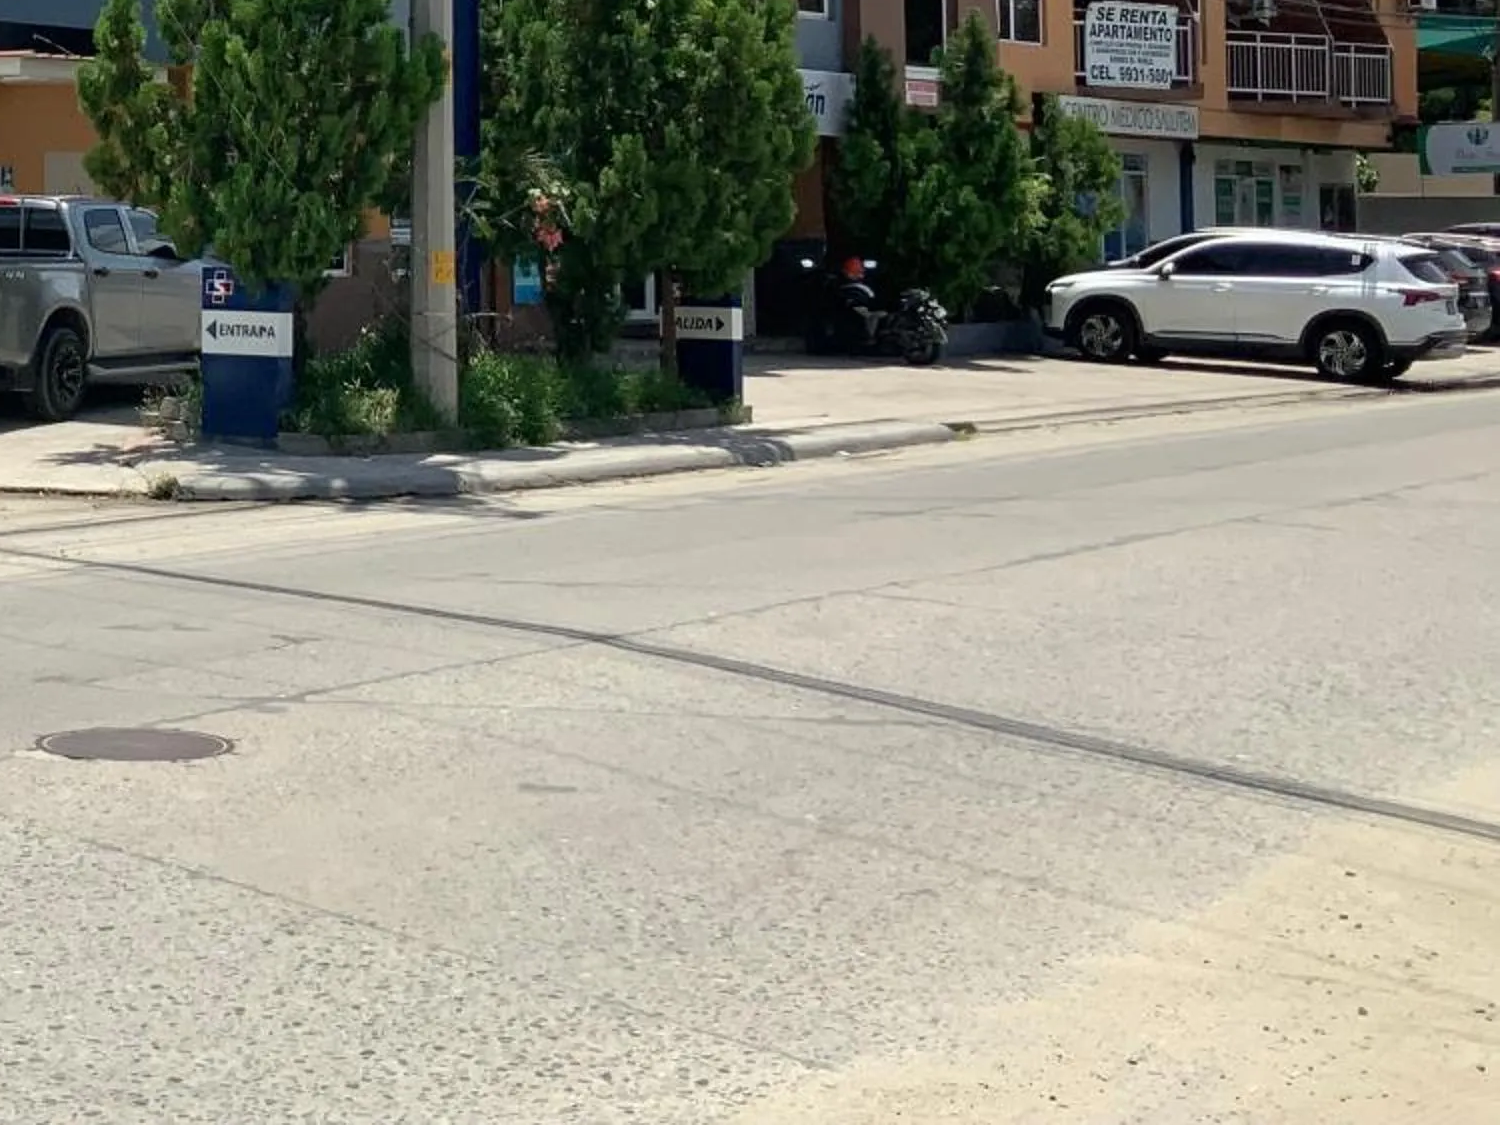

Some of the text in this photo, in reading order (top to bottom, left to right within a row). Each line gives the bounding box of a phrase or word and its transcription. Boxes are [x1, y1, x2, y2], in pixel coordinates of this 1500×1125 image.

[1096, 6, 1168, 26] SE RENTA
[1089, 23, 1173, 43] APARTAMENTO
[676, 316, 715, 331] ALIDA
